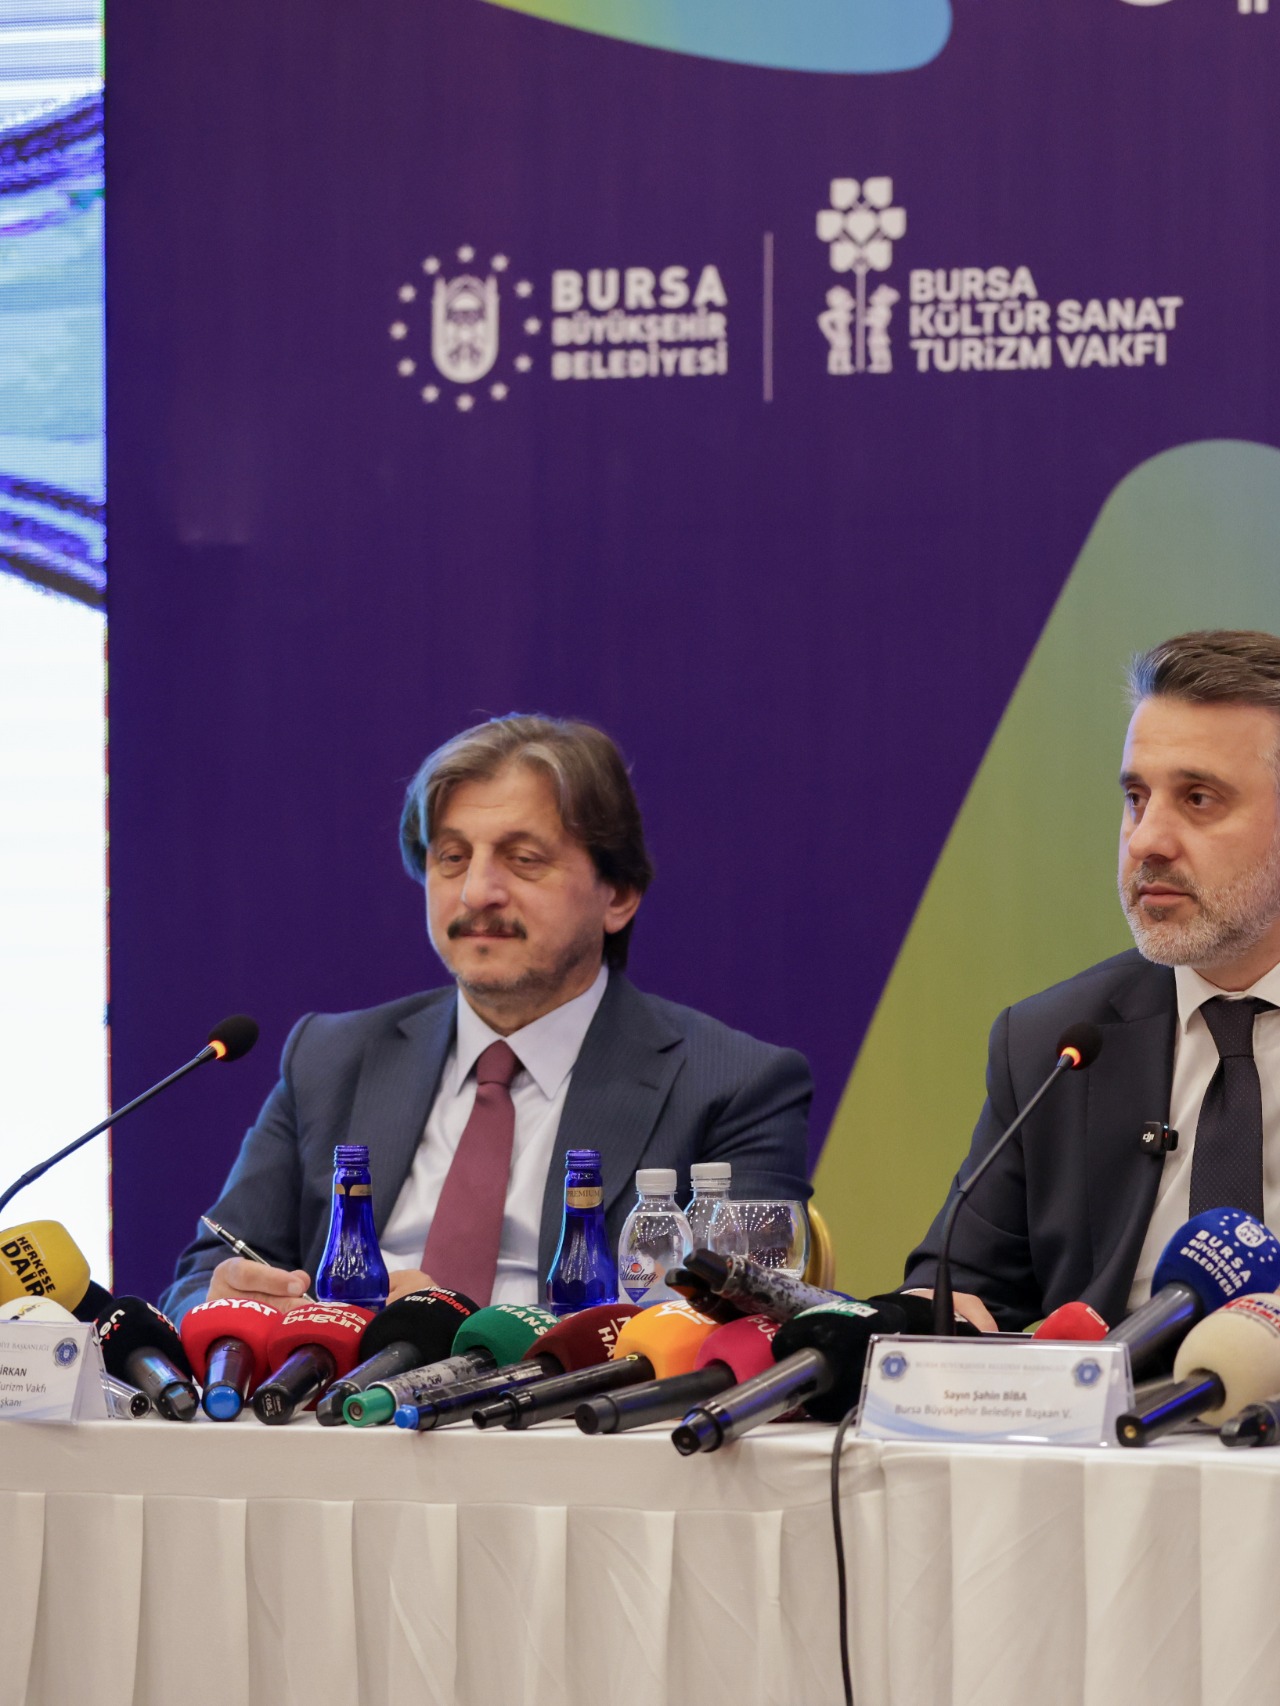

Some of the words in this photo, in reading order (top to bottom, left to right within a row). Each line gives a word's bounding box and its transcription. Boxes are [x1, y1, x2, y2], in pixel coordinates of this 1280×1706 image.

[552, 264, 728, 312] BURSA
[909, 265, 1038, 303] BURSA
[552, 308, 728, 346] BÜYÜKŞEHİR
[909, 299, 1052, 338] KÜLTÜR
[1056, 296, 1184, 333] SANAT
[552, 341, 728, 381] BELEDİYESİ
[909, 335, 1052, 373] TURİZM
[1056, 332, 1168, 369] VAKFI
[17, 1236, 56, 1293] HERKESE
[1180, 1246, 1236, 1296] BELEDİYESİ
[1195, 1230, 1251, 1282] BURSA
[191, 1299, 277, 1316] HAYAT
[944, 1390, 971, 1401] Sayın
